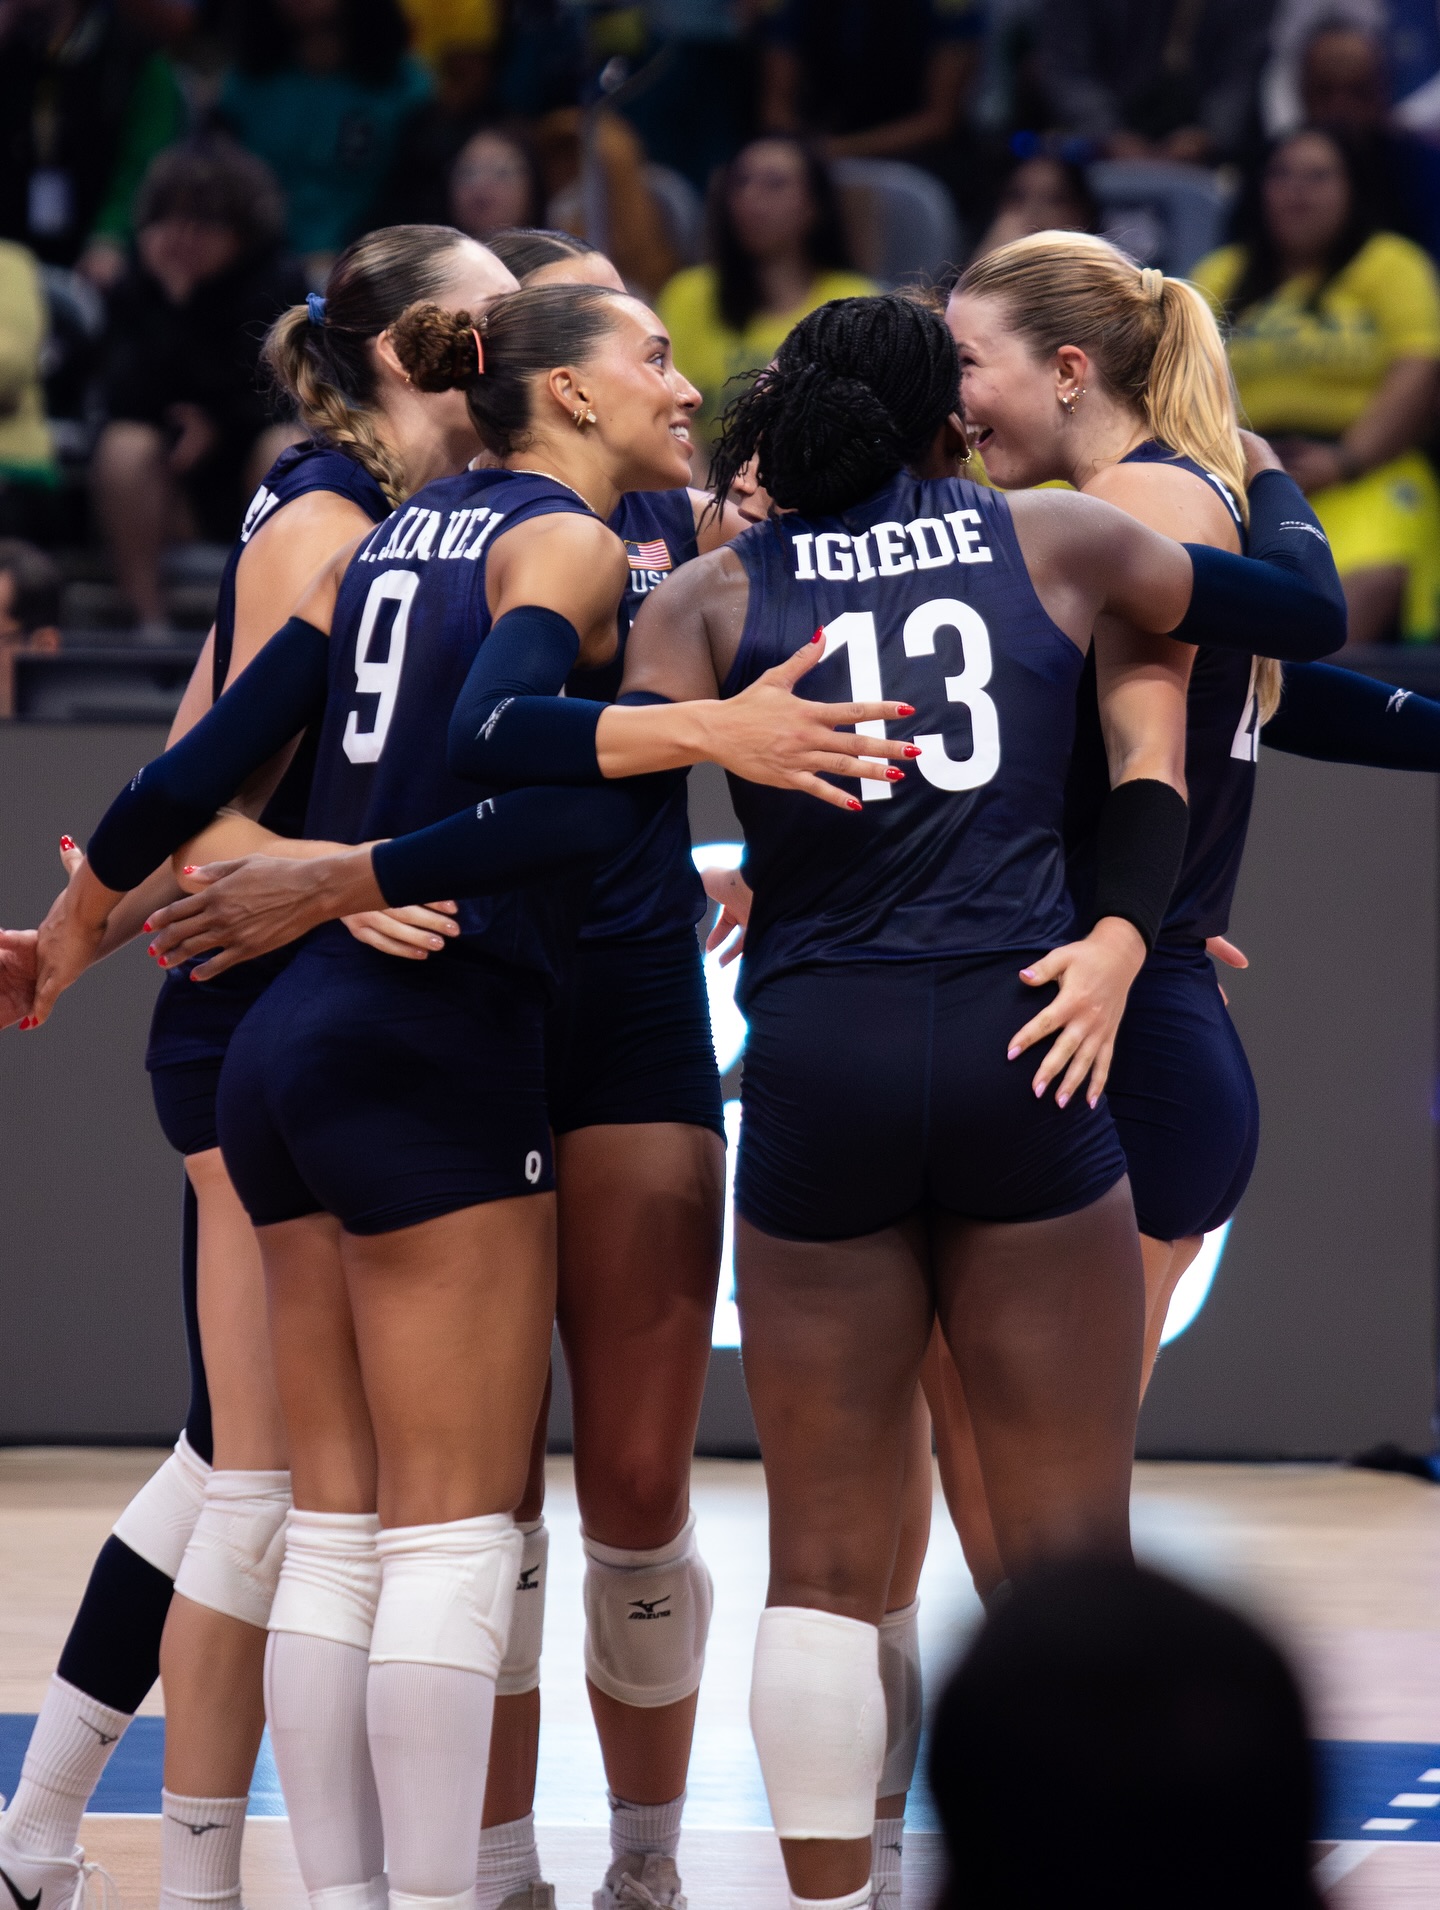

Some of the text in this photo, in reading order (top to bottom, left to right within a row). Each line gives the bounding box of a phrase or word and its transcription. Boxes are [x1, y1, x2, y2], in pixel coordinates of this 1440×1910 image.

[630, 570, 669, 593] US
[791, 508, 993, 583] IGIEDE
[342, 569, 420, 764] 9
[817, 598, 1001, 802] 13
[524, 1150, 542, 1185] 9
